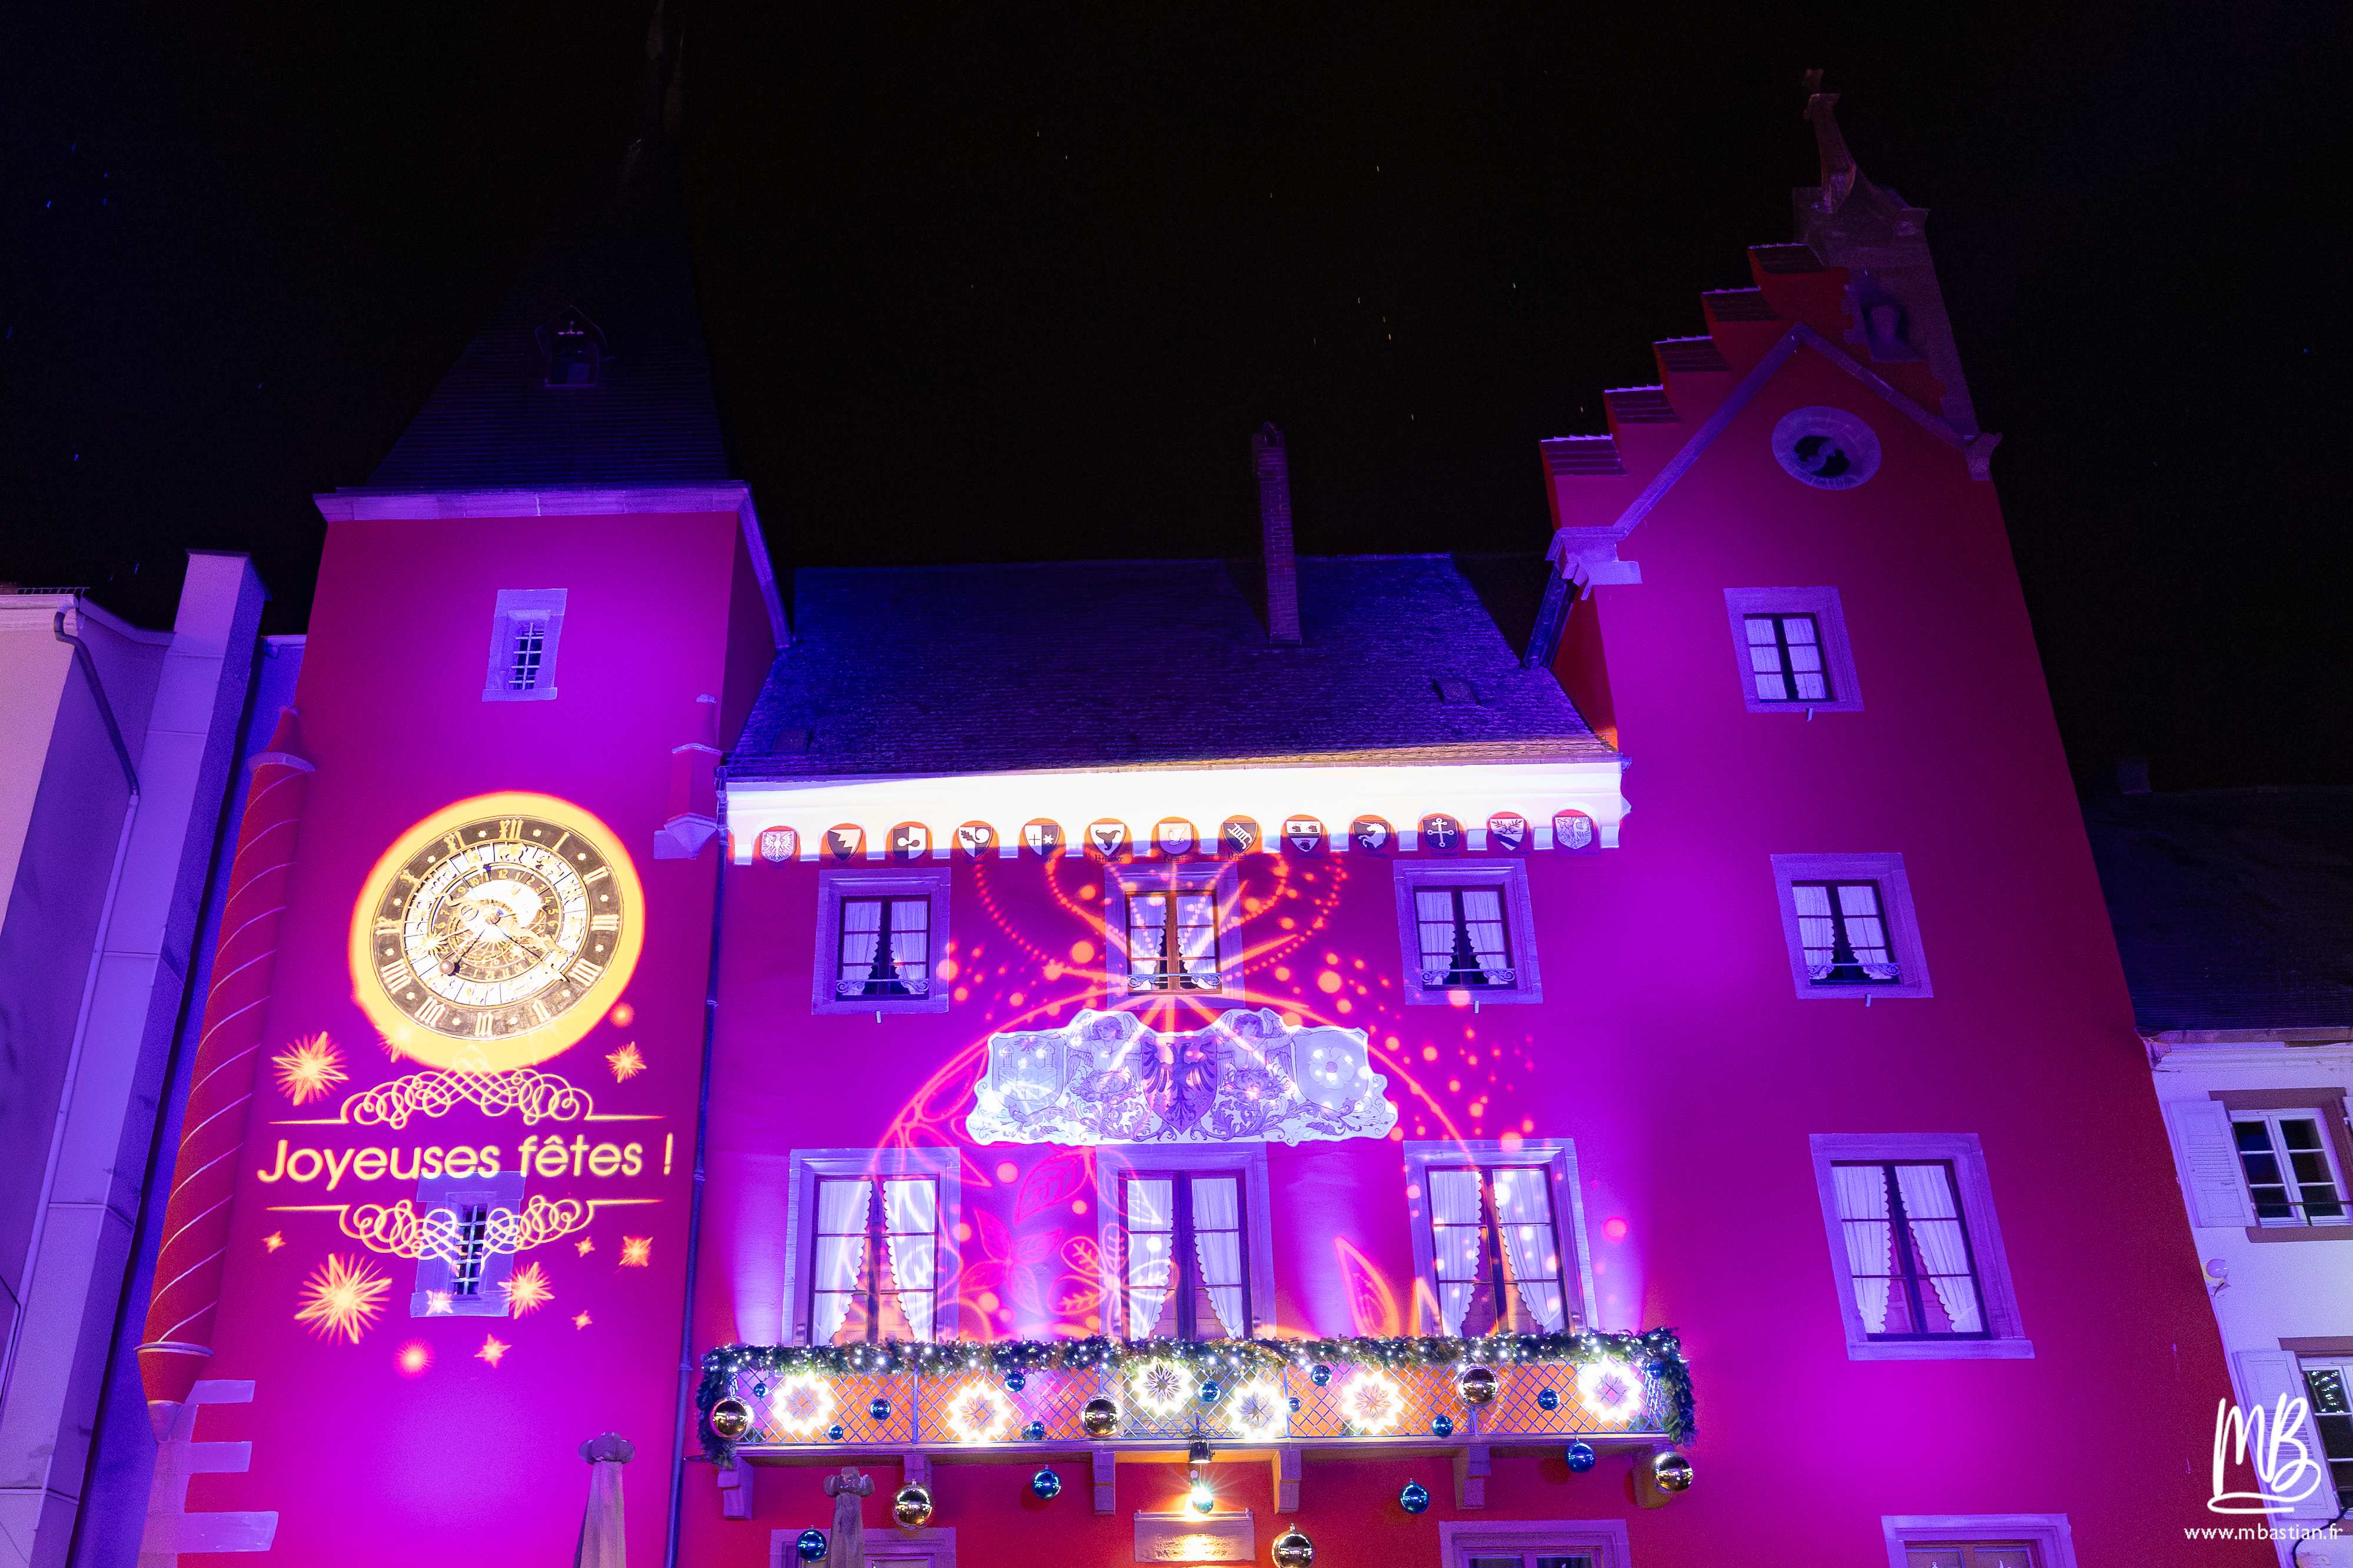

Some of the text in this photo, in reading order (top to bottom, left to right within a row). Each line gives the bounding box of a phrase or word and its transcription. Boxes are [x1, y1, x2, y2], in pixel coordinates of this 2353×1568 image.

[499, 818, 524, 840] XII
[444, 831, 466, 853] XI
[552, 831, 570, 851] I
[583, 865, 610, 884] II
[375, 916, 402, 935] IX
[591, 914, 620, 931] III
[257, 1133, 674, 1191] Joyeuses fêtes !
